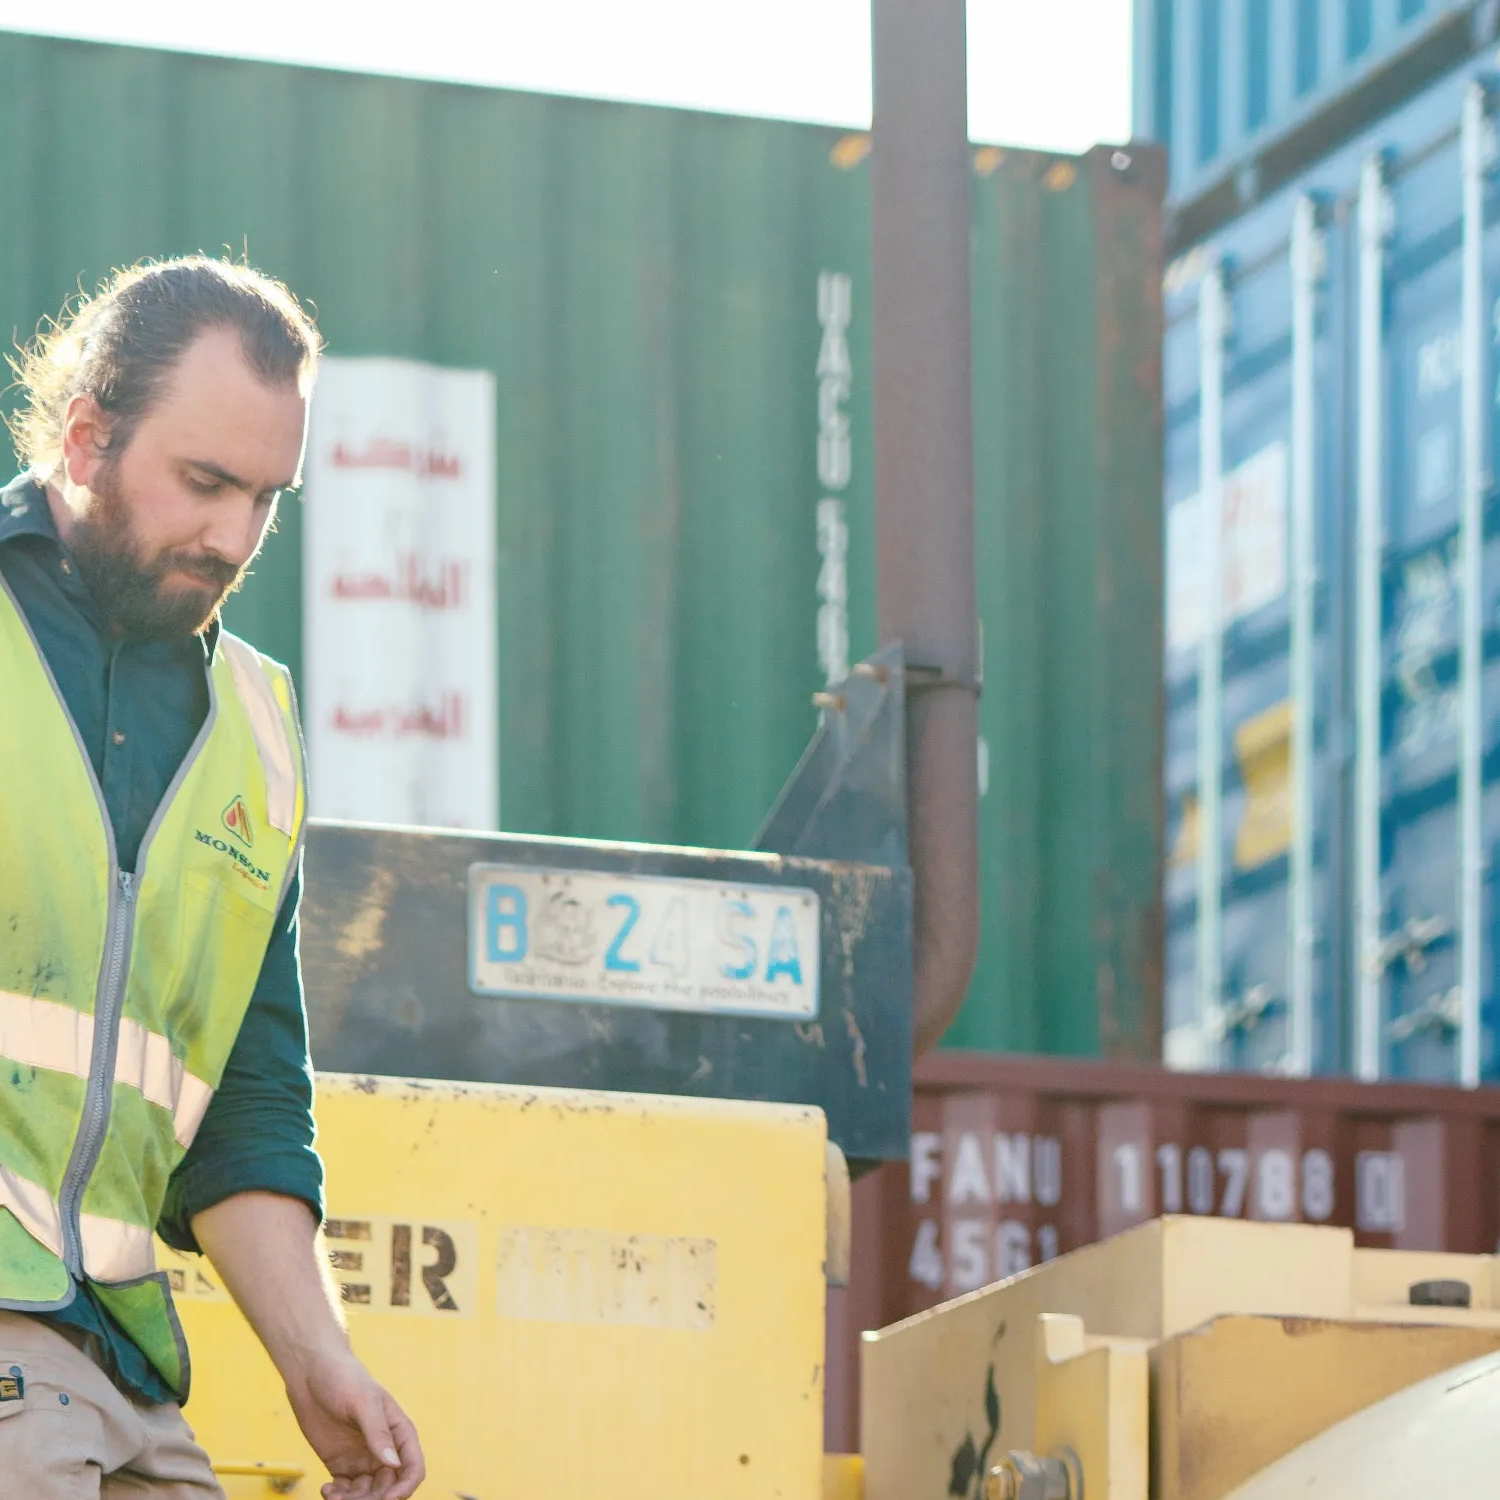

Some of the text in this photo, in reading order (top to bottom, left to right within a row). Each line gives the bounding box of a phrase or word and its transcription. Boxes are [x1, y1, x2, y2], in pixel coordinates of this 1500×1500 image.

[195, 830, 270, 882] MONSON
[486, 884, 528, 963] B
[909, 1131, 1062, 1207] FANU
[1114, 1143, 1336, 1221] 110788
